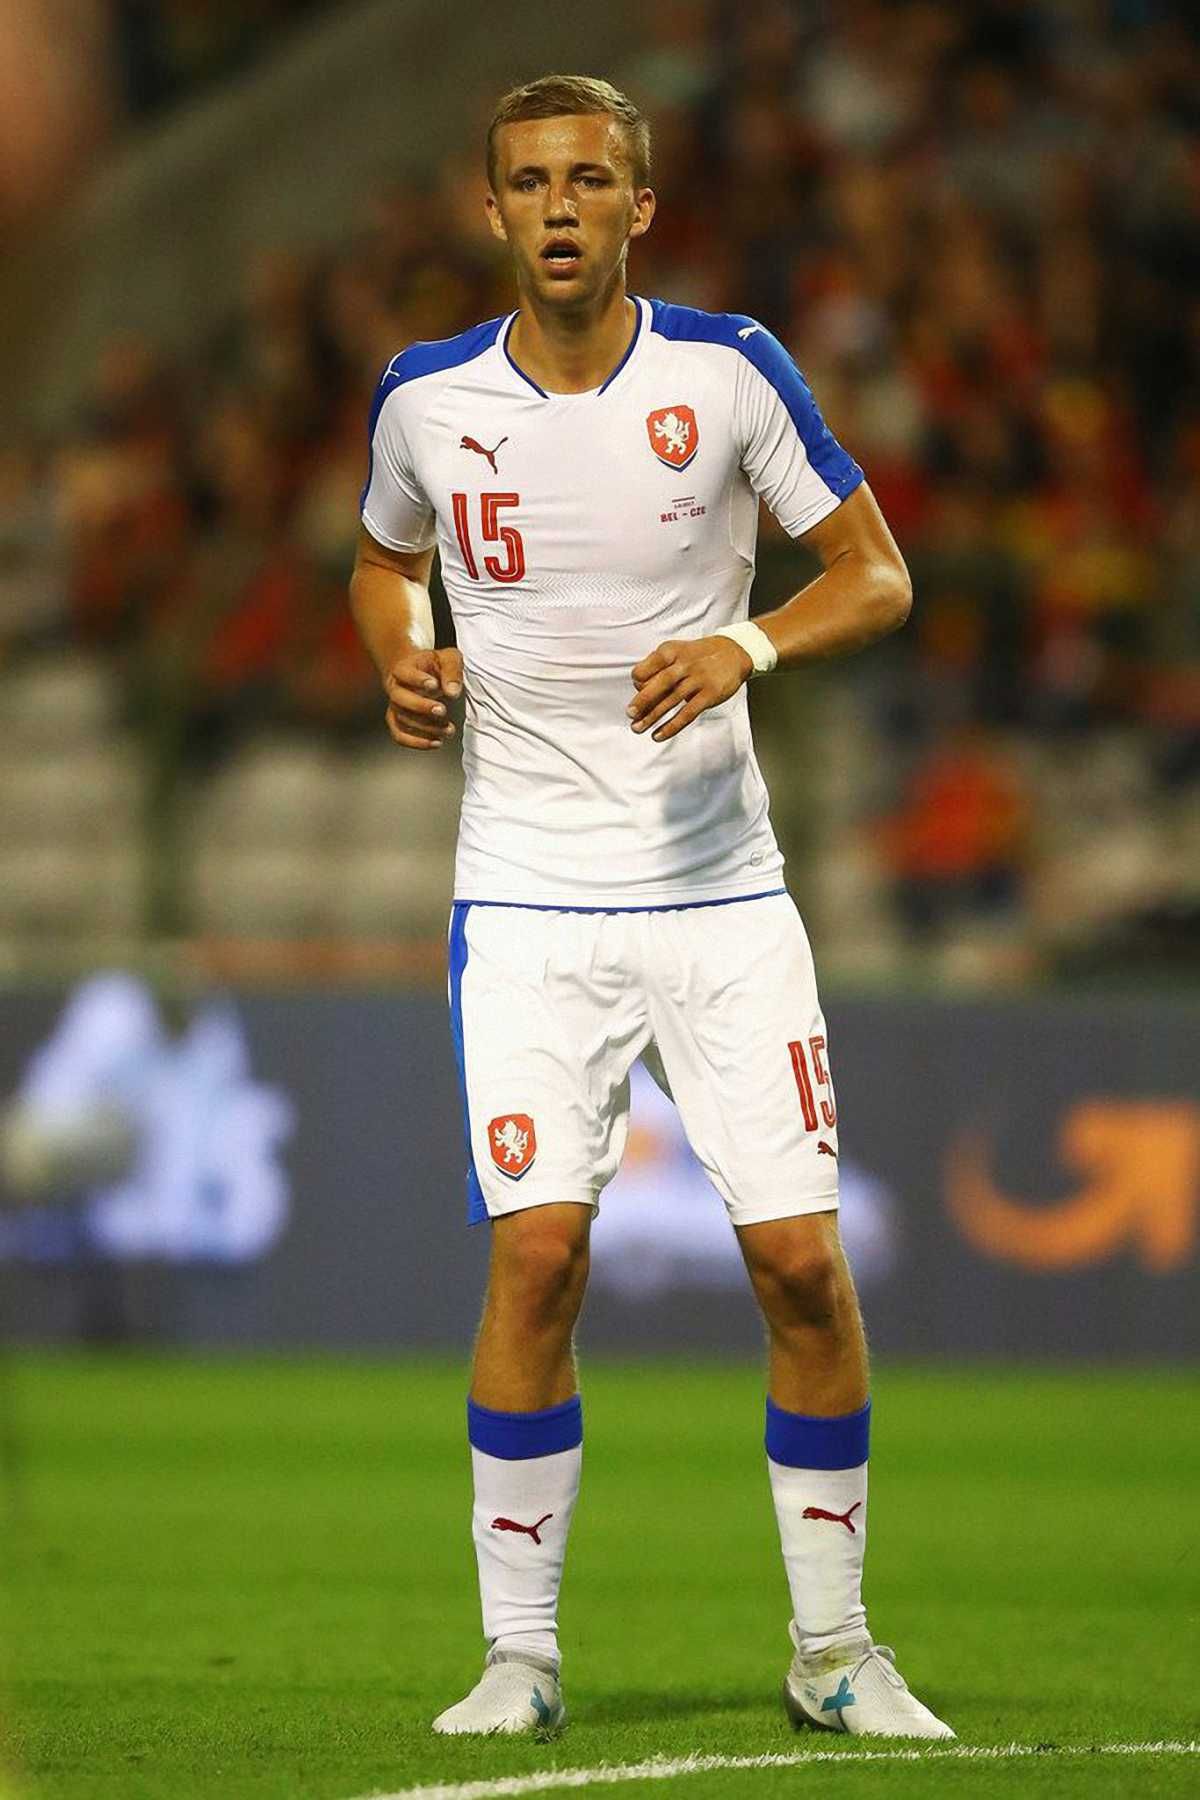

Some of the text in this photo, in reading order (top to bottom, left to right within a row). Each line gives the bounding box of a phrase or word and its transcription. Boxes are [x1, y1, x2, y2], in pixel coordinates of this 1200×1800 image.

[452, 492, 526, 583] 15
[660, 512, 678, 522] BEL
[788, 1035, 837, 1132] 15
